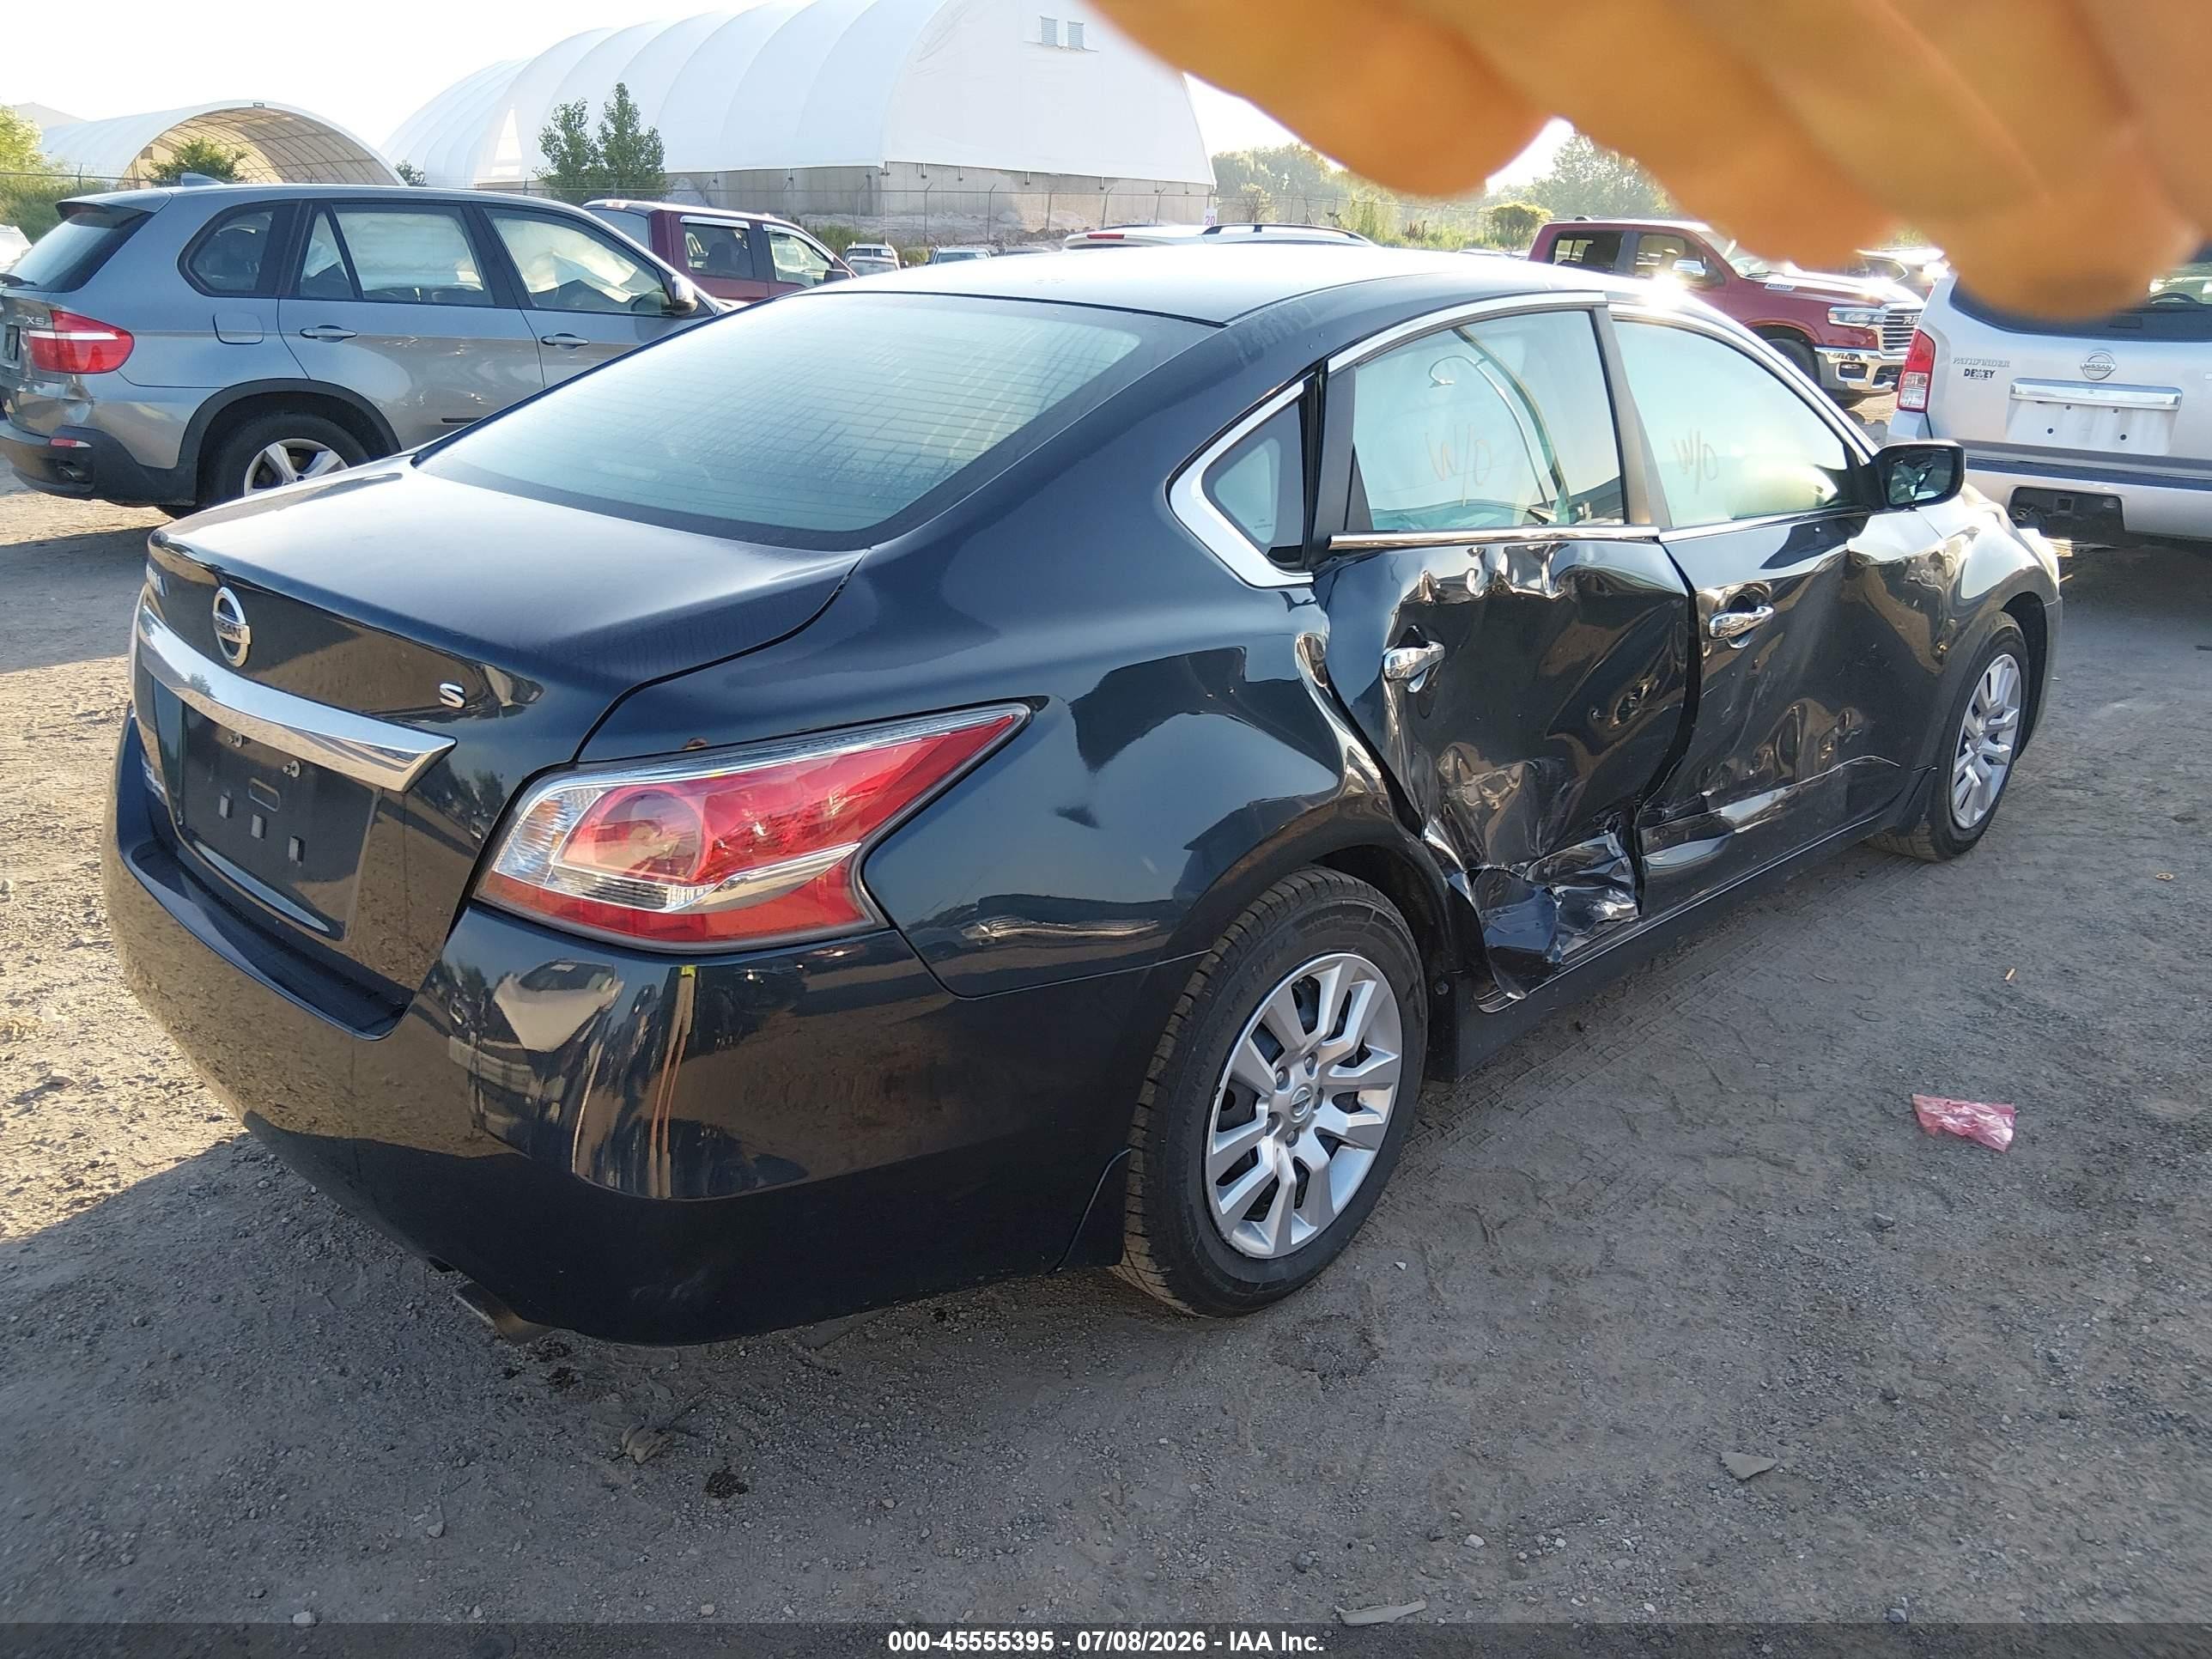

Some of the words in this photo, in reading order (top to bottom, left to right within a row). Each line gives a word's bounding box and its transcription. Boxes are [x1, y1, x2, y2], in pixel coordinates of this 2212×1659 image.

[1205, 216, 1215, 226] 20
[26, 316, 46, 325] X5
[1953, 357, 2010, 368] PATHFINDER
[439, 683, 466, 708] S
